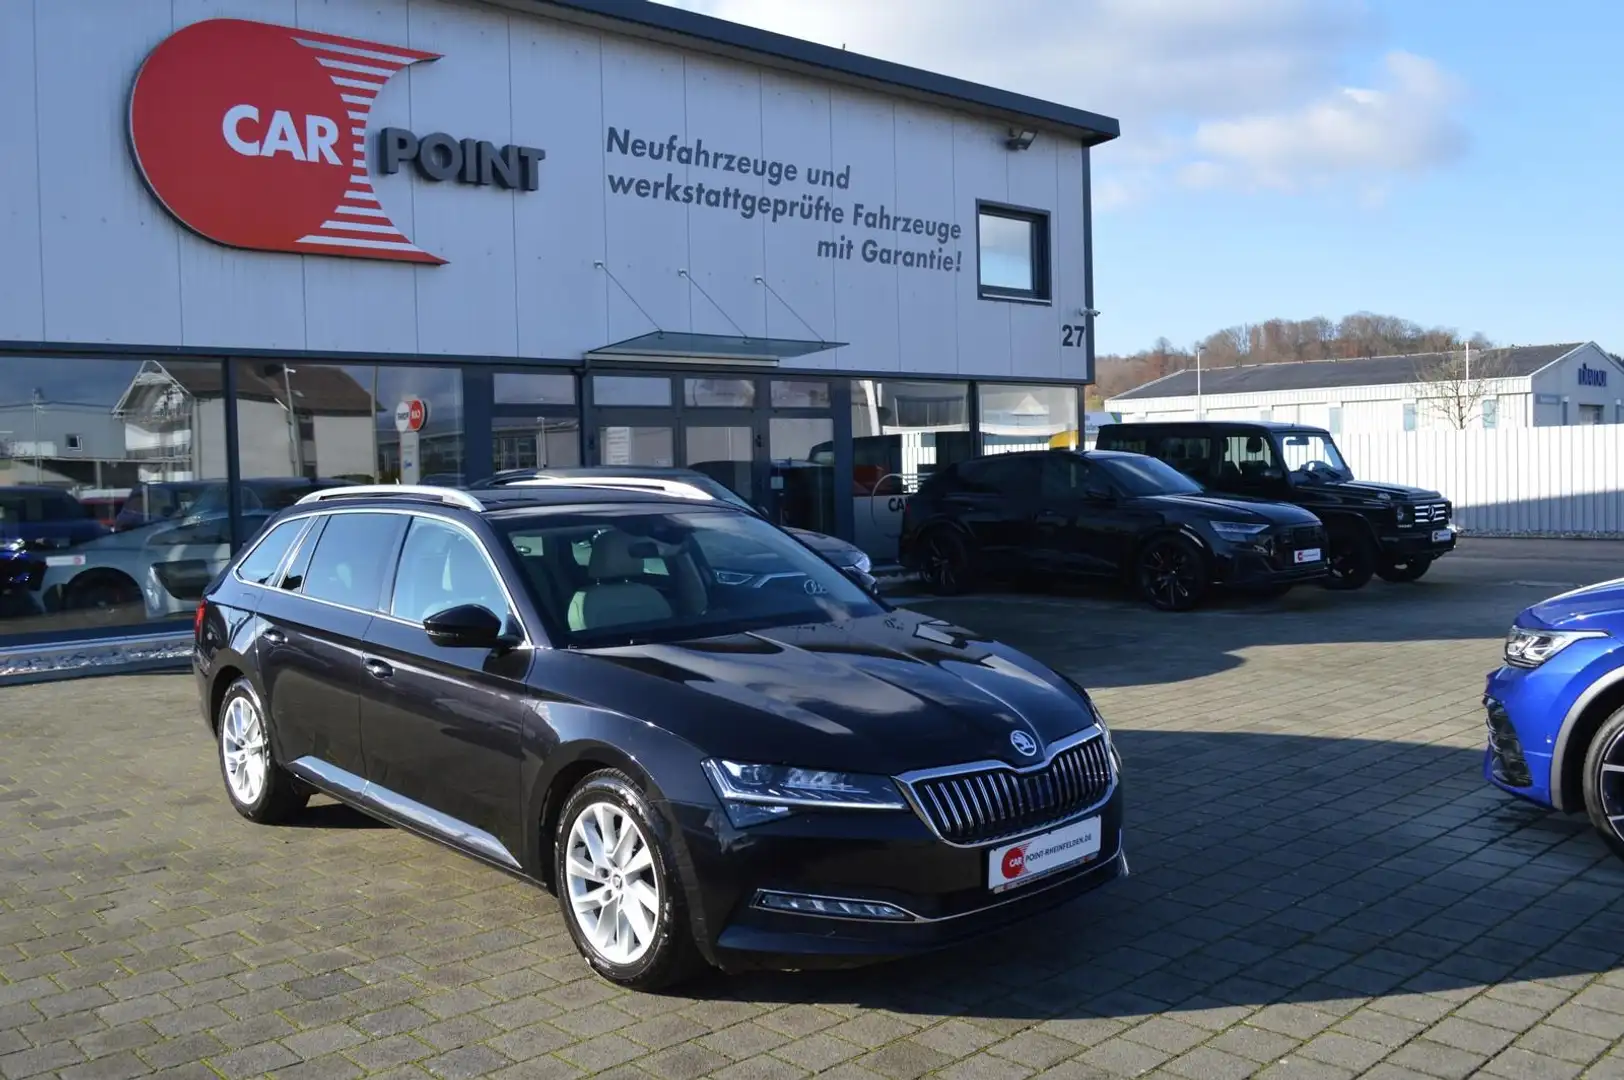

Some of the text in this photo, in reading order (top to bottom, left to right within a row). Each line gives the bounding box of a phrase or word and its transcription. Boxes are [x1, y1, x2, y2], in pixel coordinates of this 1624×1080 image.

[222, 104, 546, 192] CAR POINT
[606, 126, 851, 190] Neufahrzeuge und
[608, 173, 962, 242] werkstattgeprüfte Fahrzeuge
[816, 235, 962, 273] mit Garantie!
[1062, 325, 1085, 347] 27
[888, 497, 907, 512] CA
